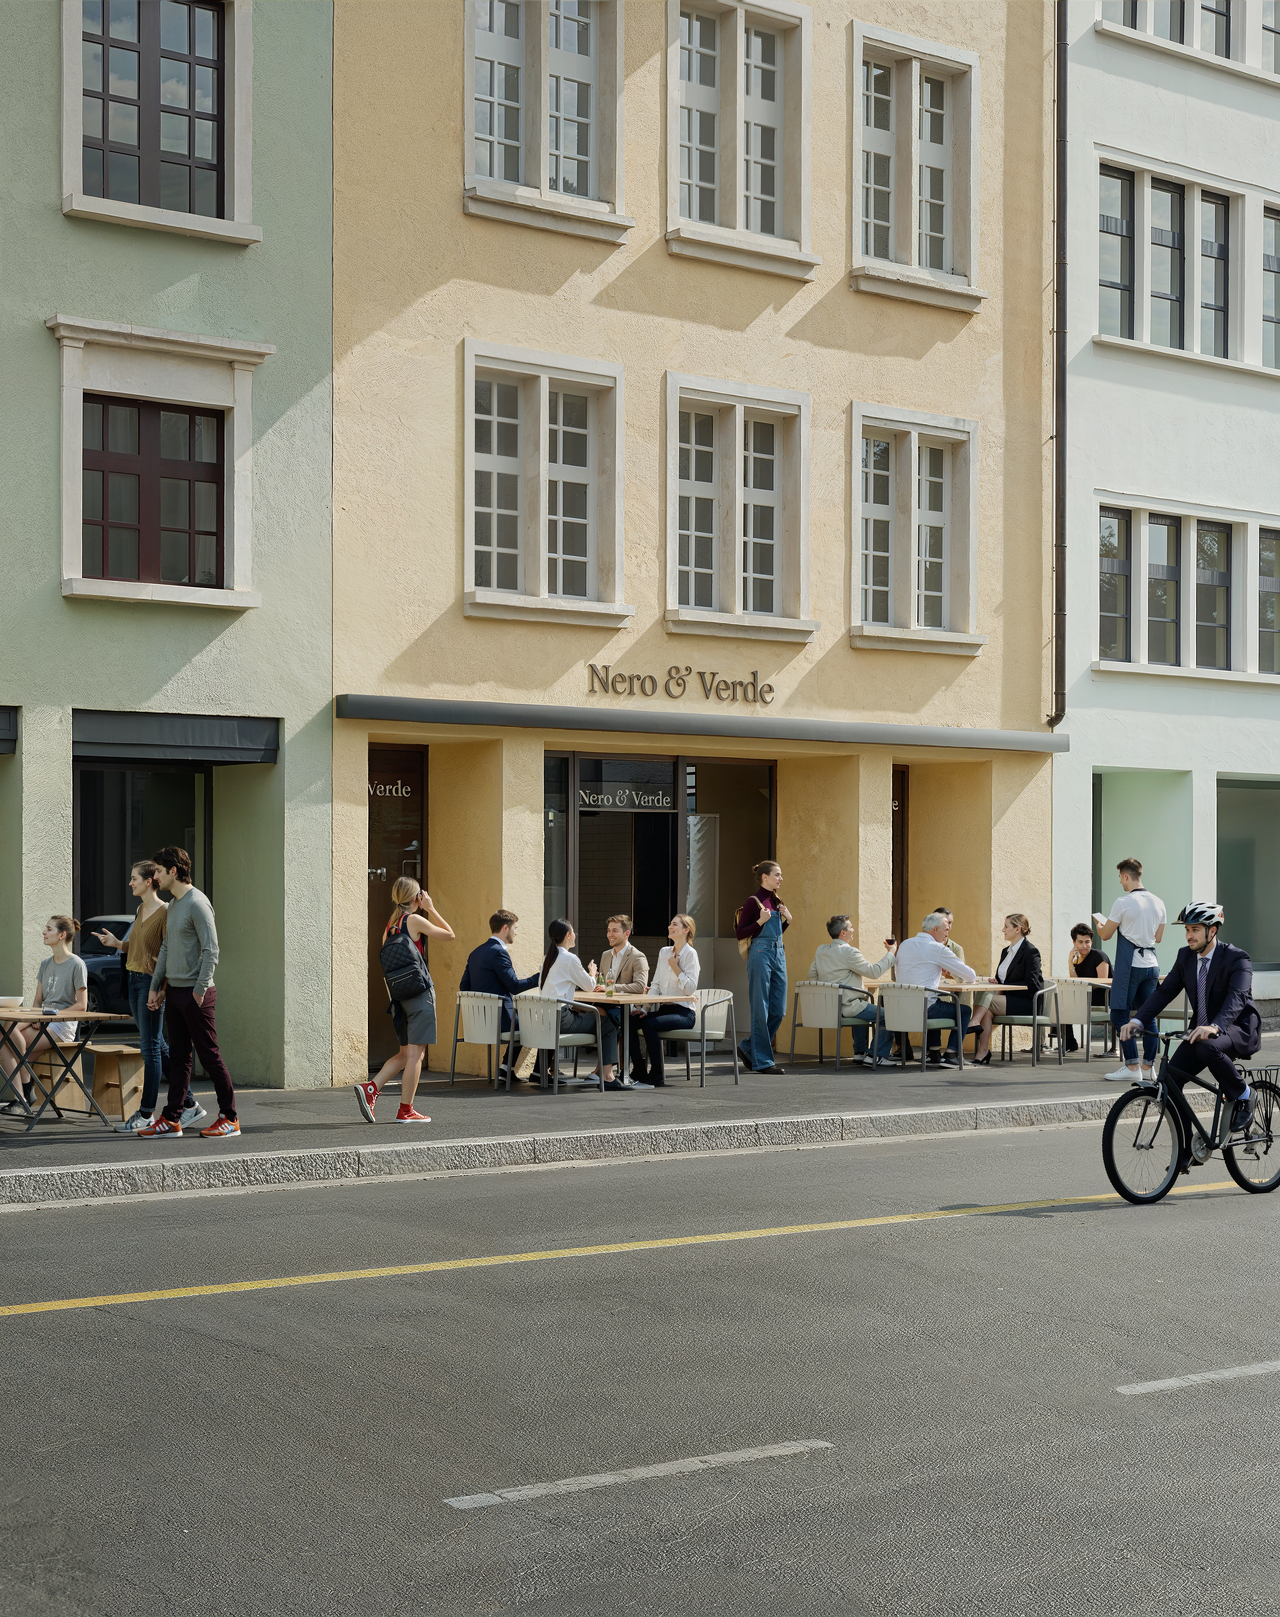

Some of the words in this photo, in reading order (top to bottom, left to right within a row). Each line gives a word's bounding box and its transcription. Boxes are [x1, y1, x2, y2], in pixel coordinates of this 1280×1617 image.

[588, 663, 658, 697] Nero
[664, 665, 693, 699] &
[696, 670, 775, 704] Verde
[578, 789, 613, 806] Nero
[615, 789, 630, 807] &
